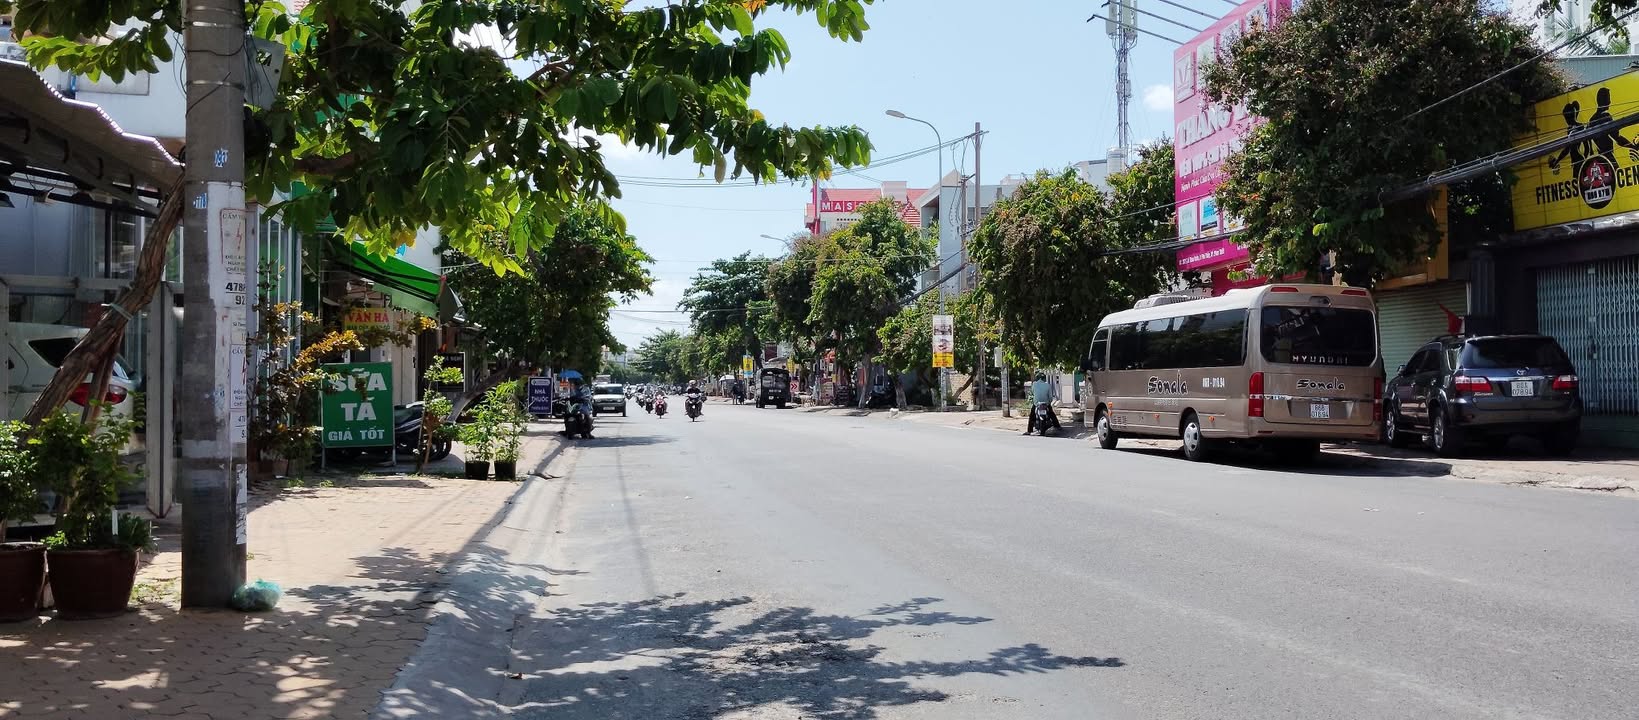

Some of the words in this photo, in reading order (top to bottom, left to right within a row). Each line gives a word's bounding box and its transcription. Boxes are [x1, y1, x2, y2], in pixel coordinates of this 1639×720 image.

[1536, 178, 1580, 205] FITNESS
[1292, 355, 1348, 365] HYUNDAI
[328, 426, 353, 441] GIÁ
[359, 425, 385, 440] TỐT
